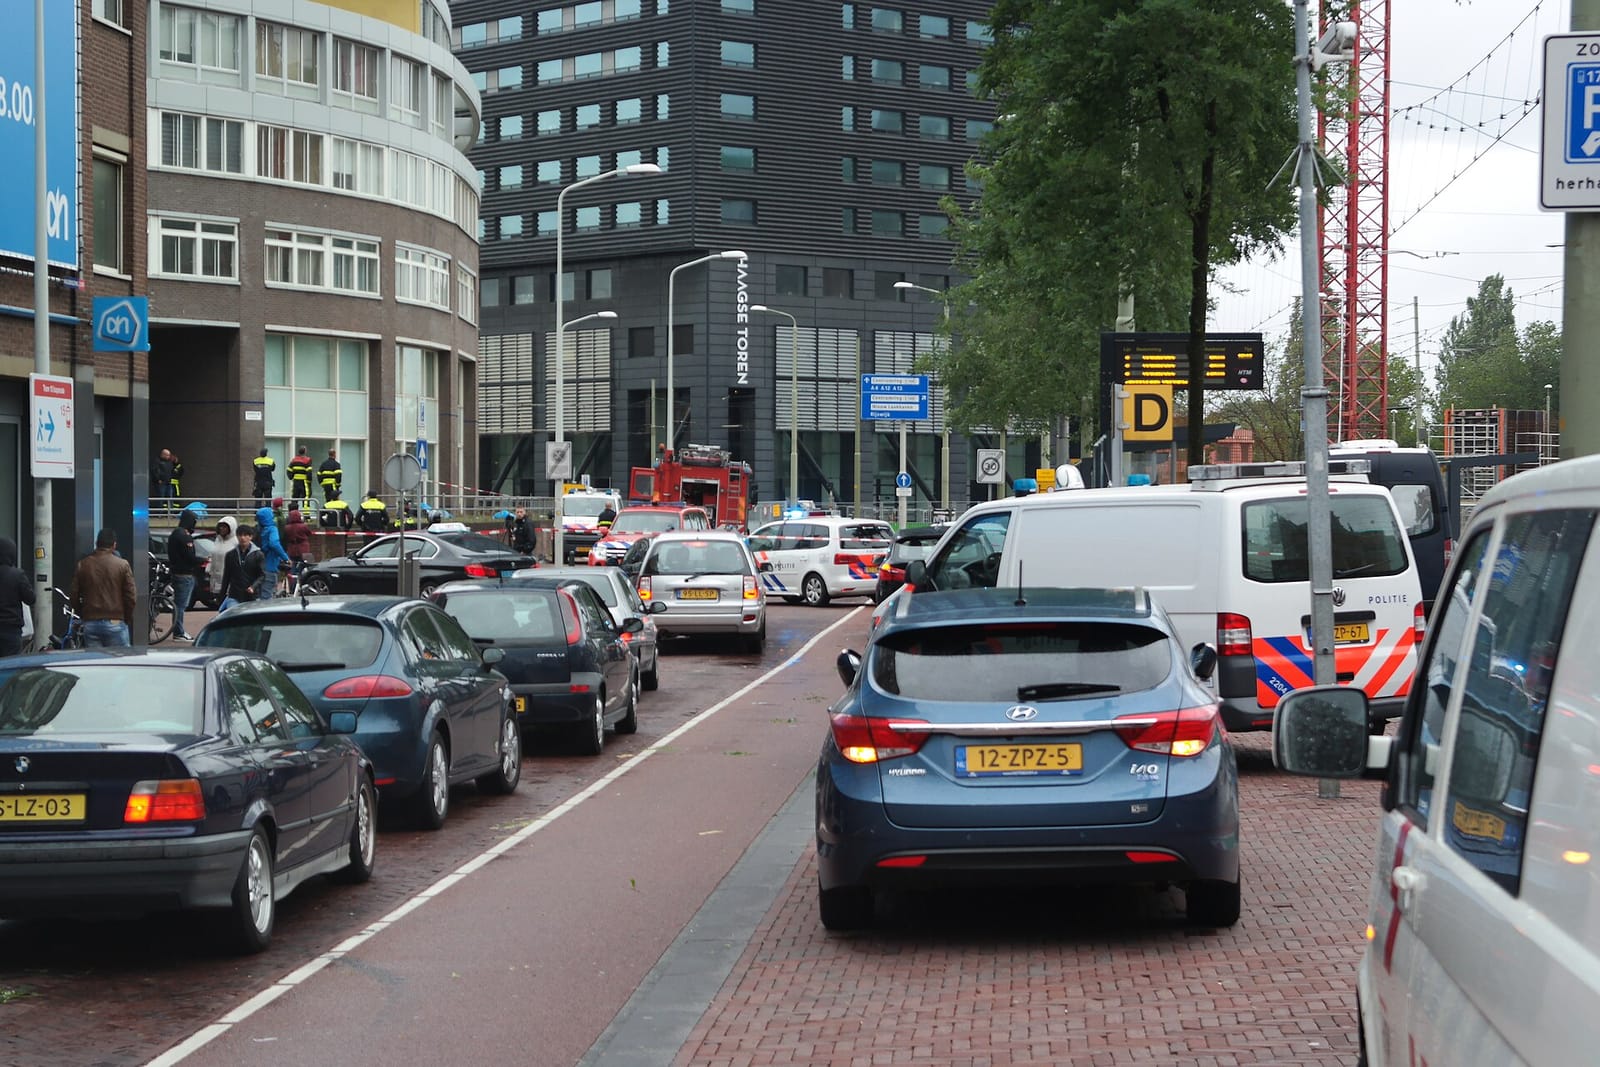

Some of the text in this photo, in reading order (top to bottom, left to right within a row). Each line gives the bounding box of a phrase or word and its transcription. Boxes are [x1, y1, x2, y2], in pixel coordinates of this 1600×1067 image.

[737, 257, 748, 384] HAAGSE TOREN
[1135, 394, 1168, 432] D
[984, 462, 997, 471] 30
[1368, 594, 1407, 604] POLITIE
[1269, 676, 1288, 694] 2204
[978, 748, 1069, 768] 12-ZPZ-5
